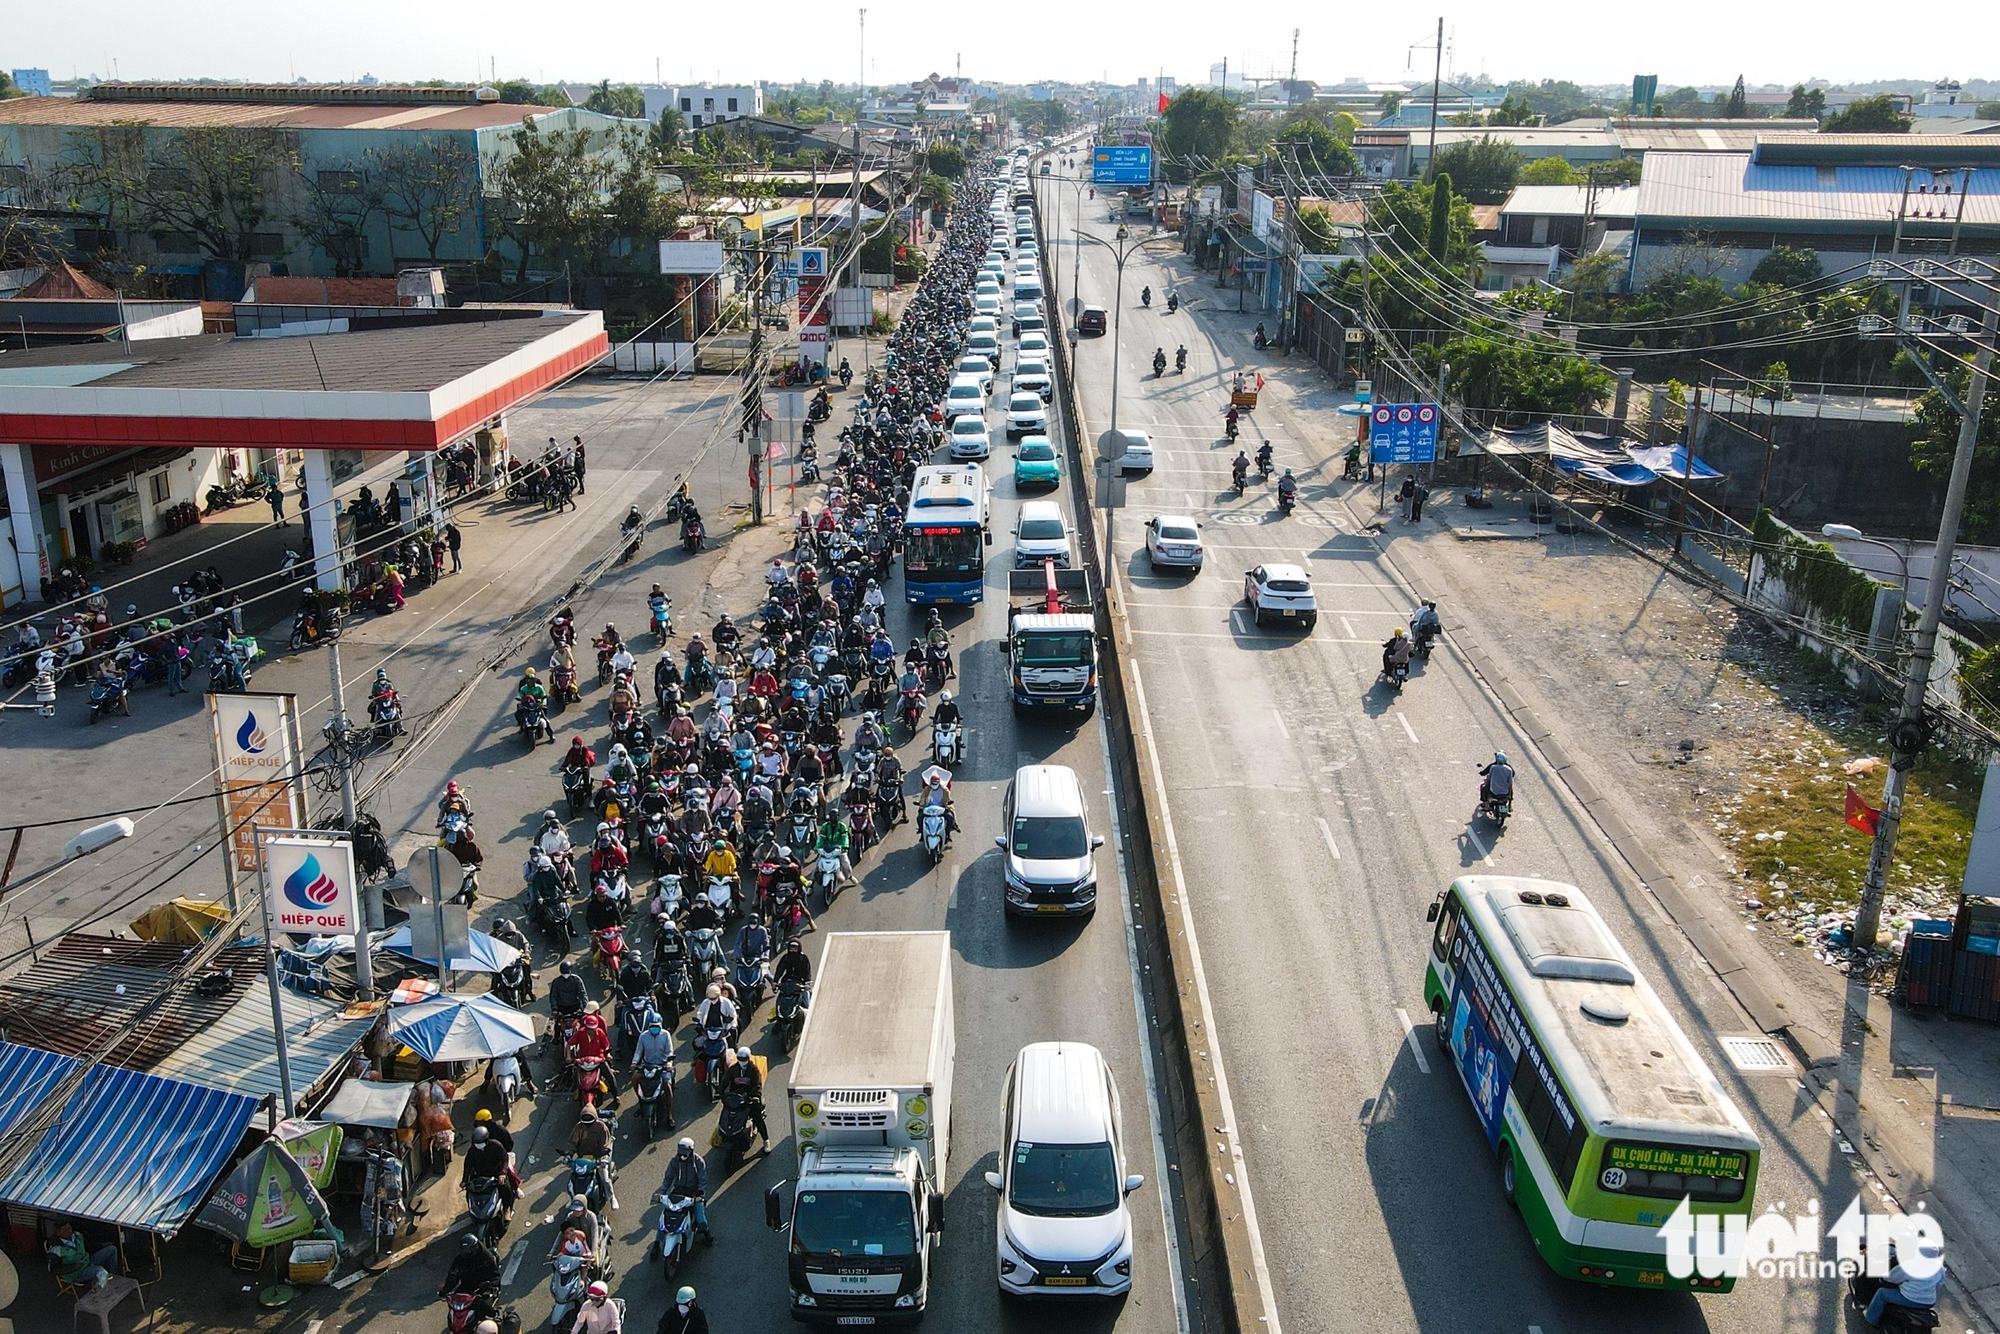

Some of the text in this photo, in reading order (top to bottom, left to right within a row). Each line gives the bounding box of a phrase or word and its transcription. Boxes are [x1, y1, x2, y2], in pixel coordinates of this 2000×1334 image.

[1379, 411, 1388, 420] 60
[1401, 410, 1409, 419] 60
[1422, 410, 1431, 419] 60
[281, 912, 346, 927] HIỆP QUẾ
[1612, 1147, 1627, 1160] BX
[1629, 1149, 1653, 1165] CHỢ
[1680, 1153, 1695, 1167] BX
[1697, 1153, 1718, 1168] TÂN
[1720, 1156, 1740, 1171] TRỤ
[1604, 1171, 1623, 1186] 621
